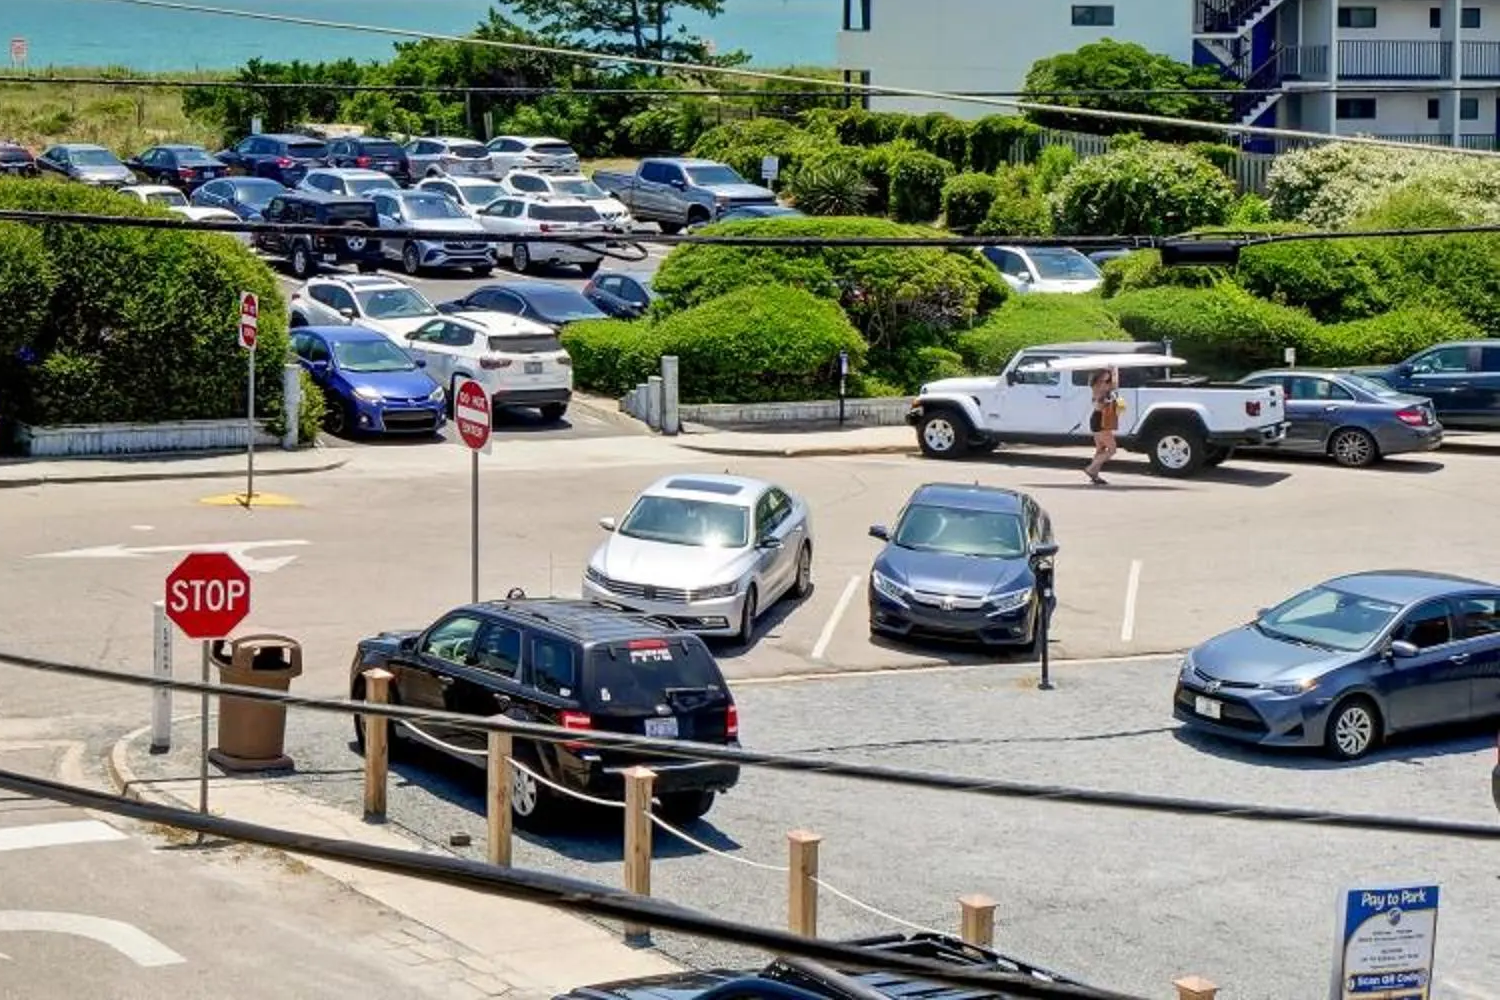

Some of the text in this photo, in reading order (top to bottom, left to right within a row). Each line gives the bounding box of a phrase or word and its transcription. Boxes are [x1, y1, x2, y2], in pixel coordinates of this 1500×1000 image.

[169, 579, 246, 612] STOP
[1361, 887, 1426, 911] Pay to Park
